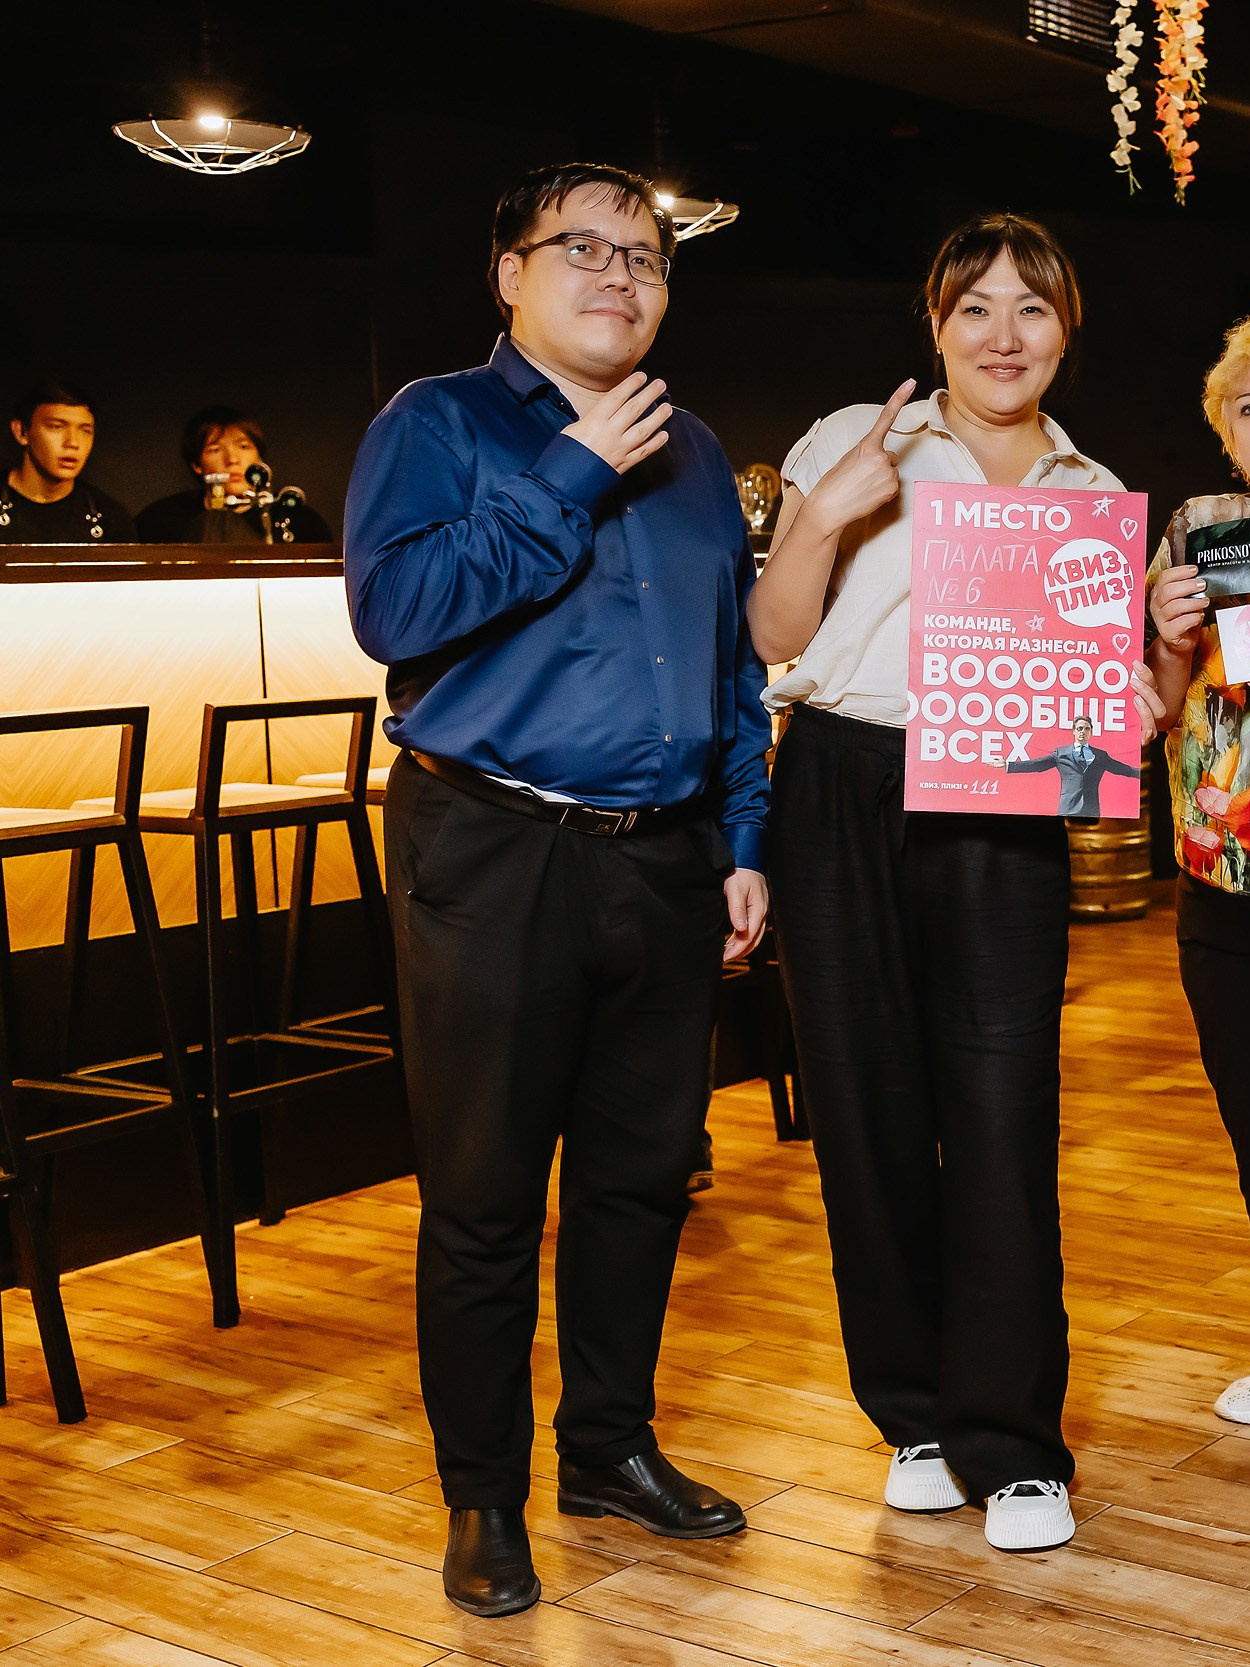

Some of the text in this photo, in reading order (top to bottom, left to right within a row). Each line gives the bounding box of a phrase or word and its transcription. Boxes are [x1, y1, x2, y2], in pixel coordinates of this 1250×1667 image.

[930, 500, 1072, 532] 1 МЕСТО
[923, 539, 1039, 575] ПАЛАТА
[926, 575, 986, 604] № 6
[1048, 575, 1133, 613] ПЛИЗ!
[924, 614, 1017, 634] КОМАНДЕ,
[923, 634, 1100, 655] КОТОРАЯ РАЗНЕСЛА
[922, 652, 1138, 694] ВООООО
[920, 728, 1033, 763] ВСЕХ
[969, 780, 999, 795] 111
